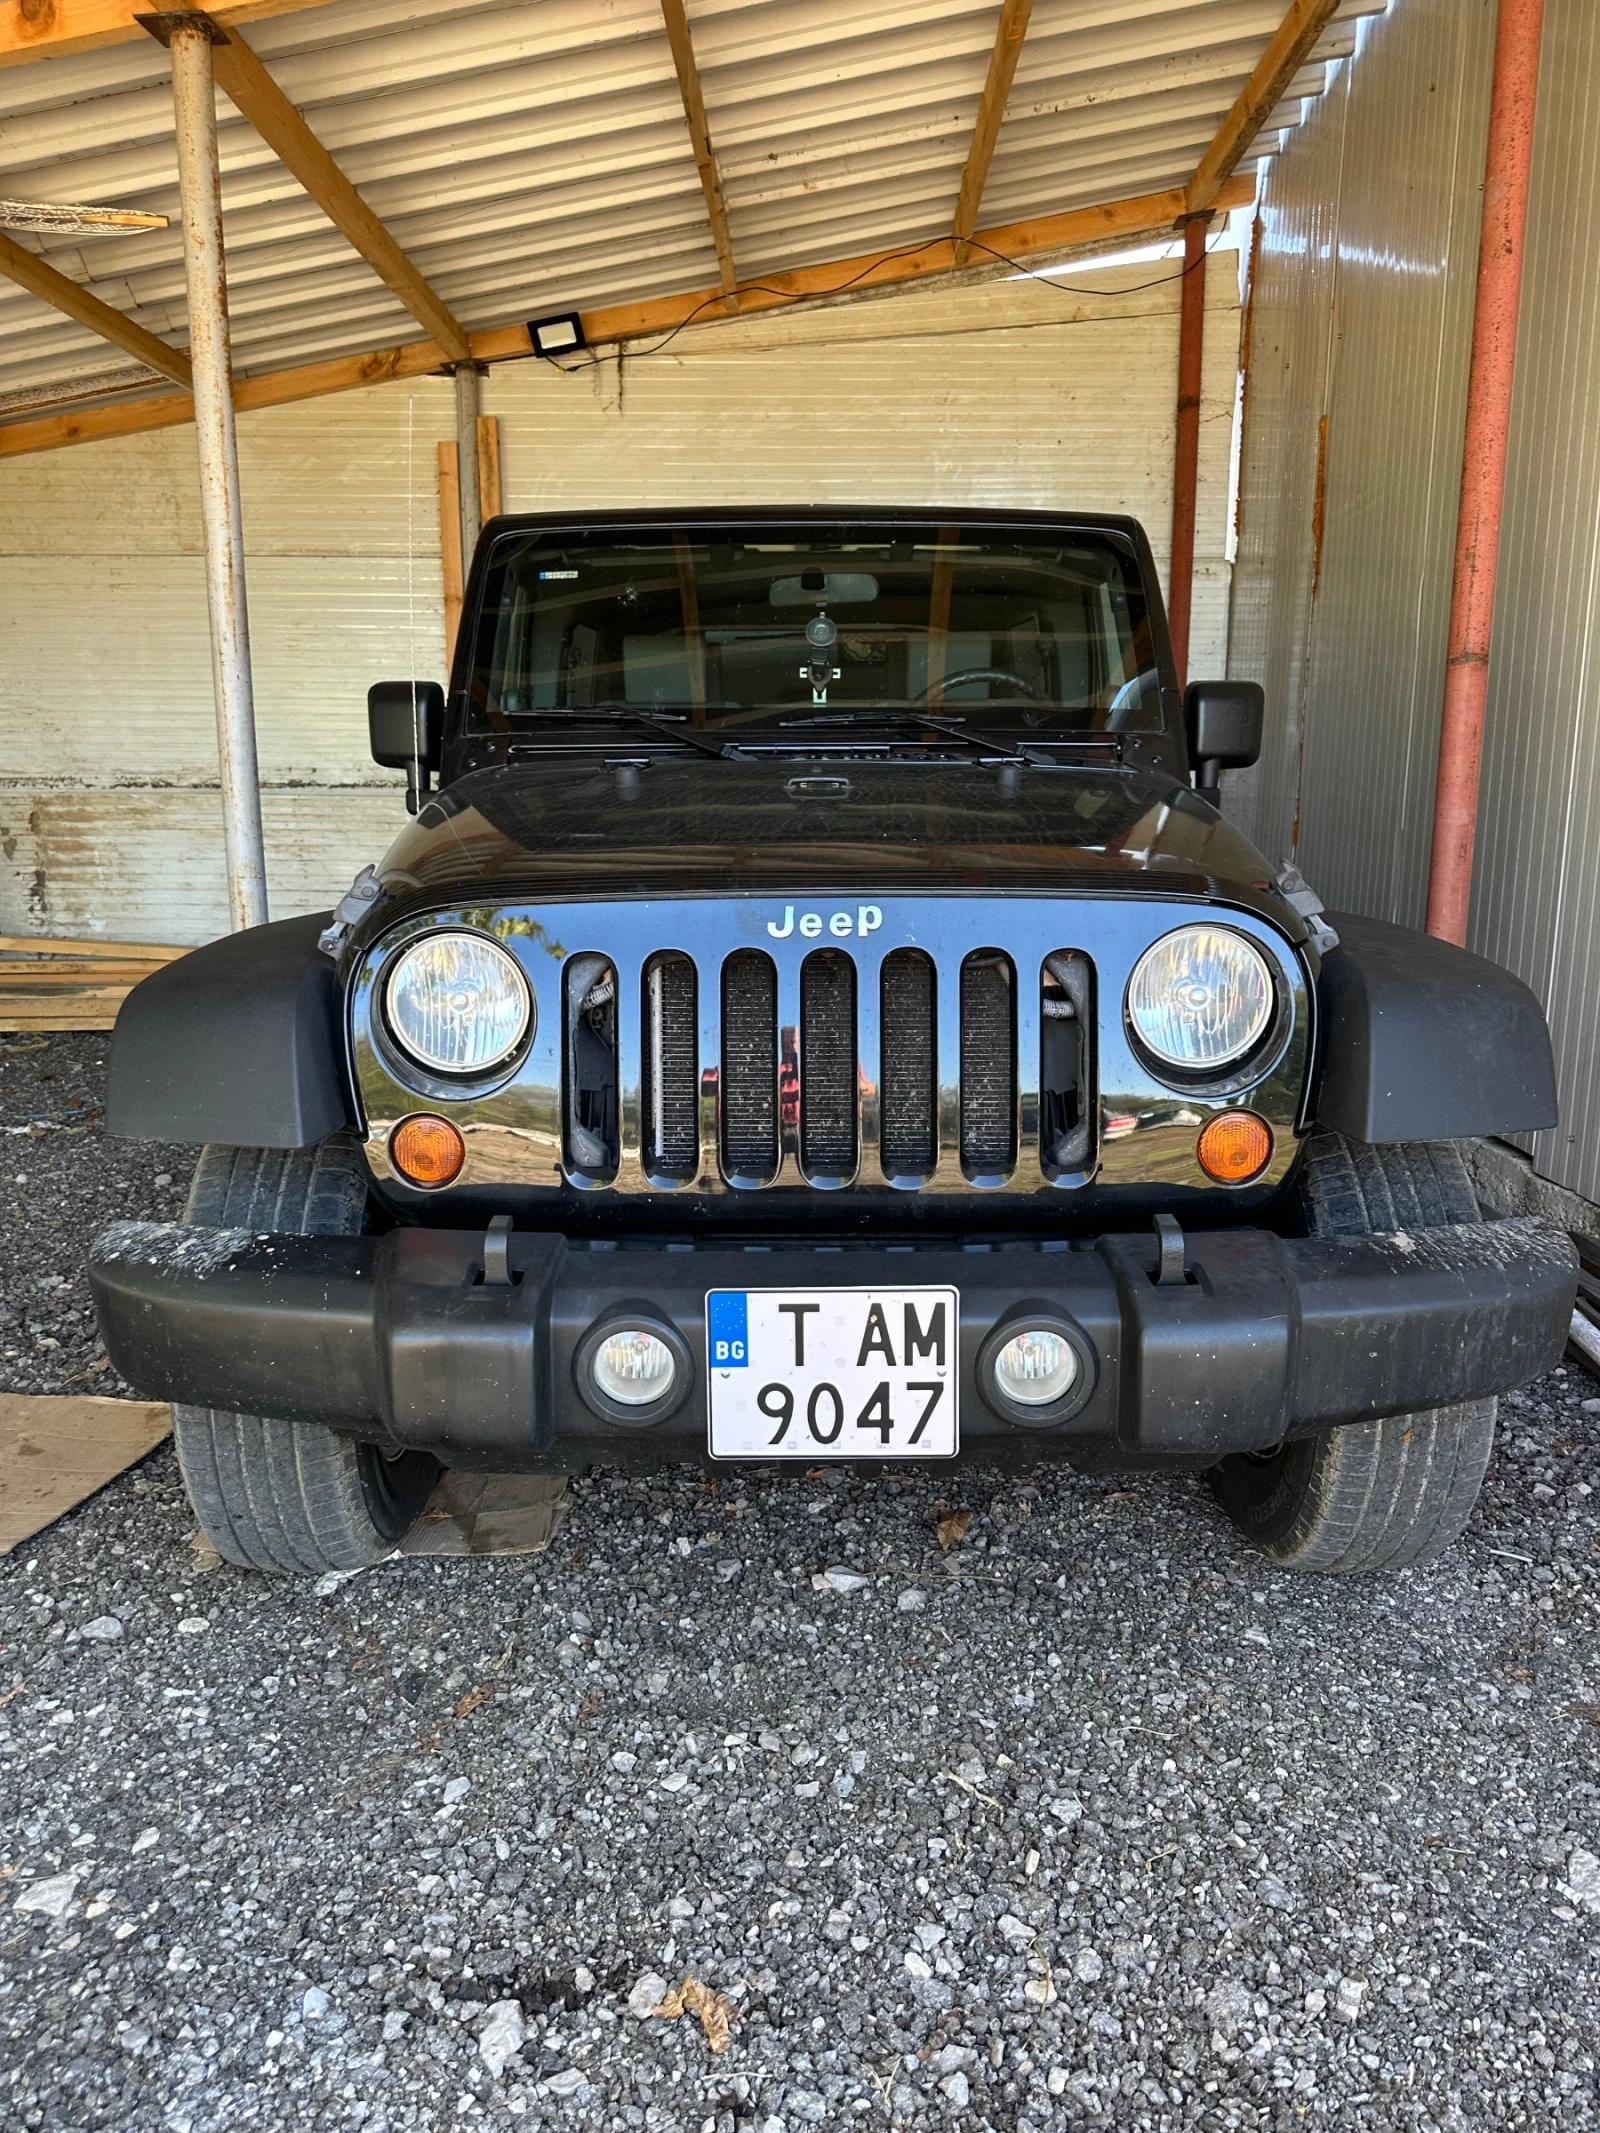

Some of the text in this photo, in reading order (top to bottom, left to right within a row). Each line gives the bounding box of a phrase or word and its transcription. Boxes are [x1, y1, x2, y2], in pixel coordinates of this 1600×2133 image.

[767, 905, 883, 938] Jeep
[715, 1340, 745, 1360] BG
[778, 1302, 946, 1367] T AM
[757, 1381, 944, 1445] 9047
